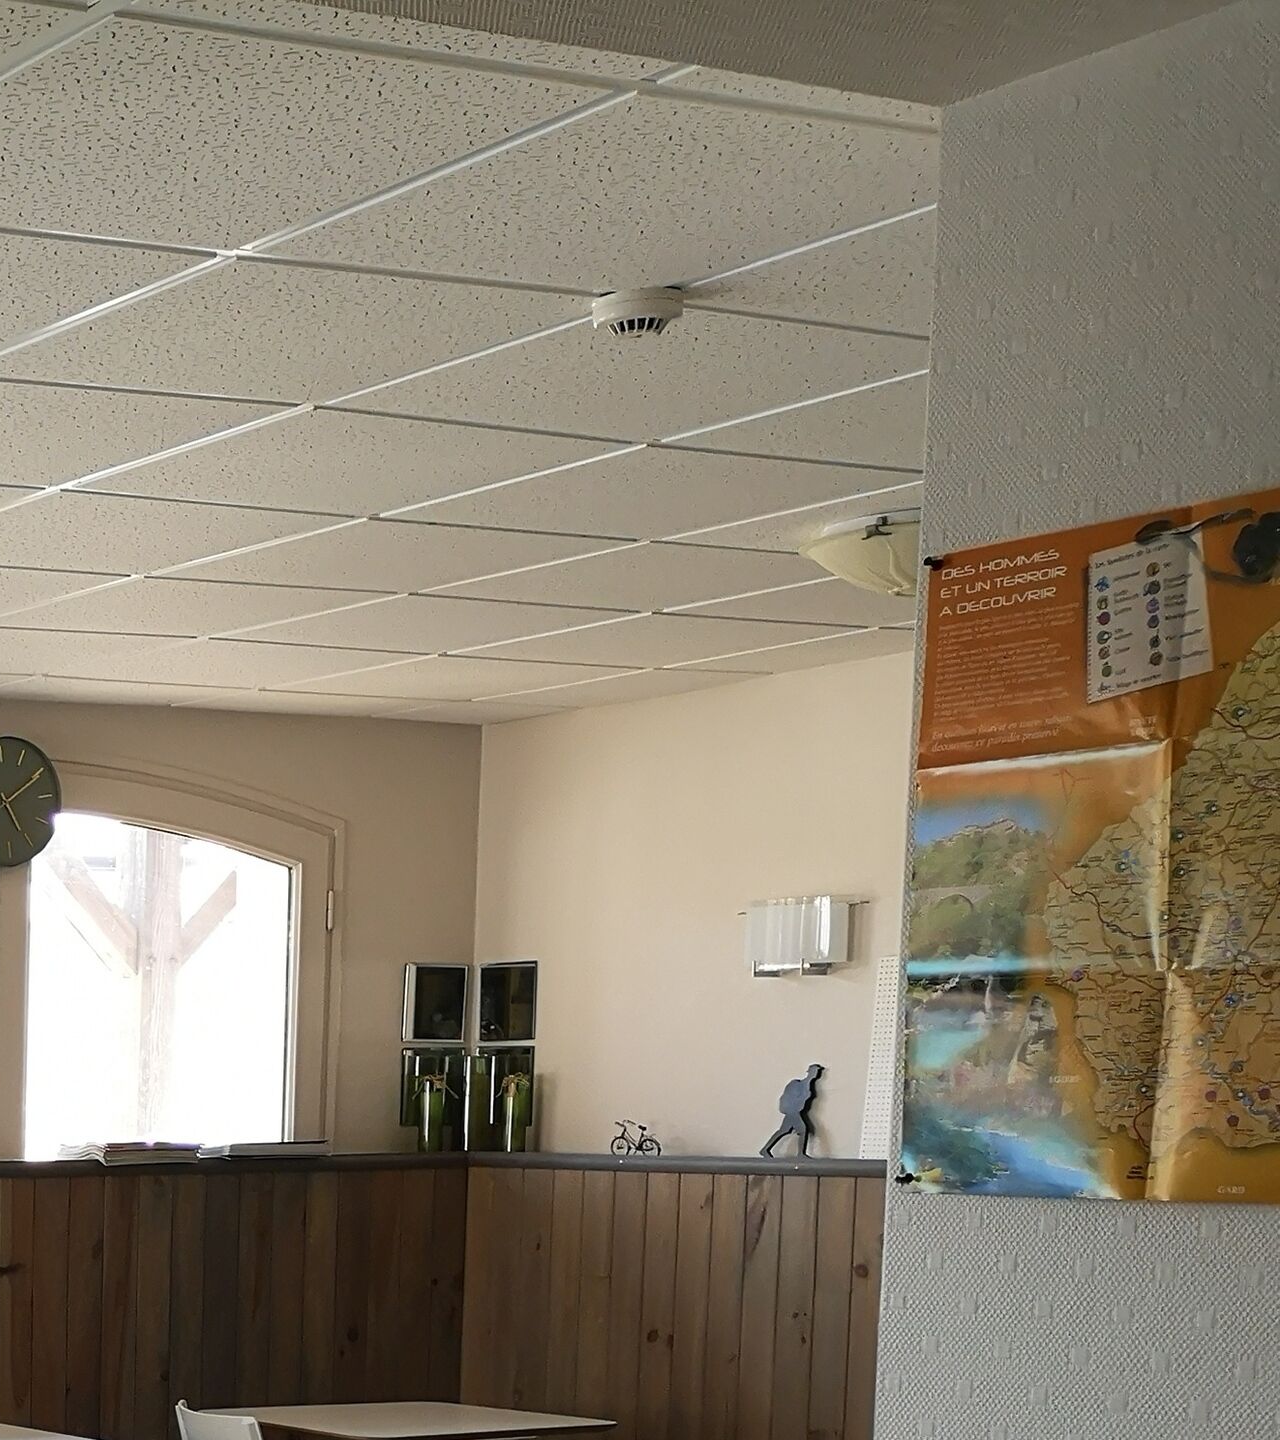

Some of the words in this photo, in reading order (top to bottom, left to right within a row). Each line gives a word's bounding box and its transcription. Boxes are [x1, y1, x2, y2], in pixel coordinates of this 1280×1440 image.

[941, 564, 975, 580] DES
[979, 549, 1060, 573] HOMMES
[940, 585, 963, 599] ET
[965, 580, 991, 594] UN
[993, 565, 1068, 588] TERROIR
[939, 606, 953, 618] A
[956, 587, 1057, 615] DECOUVRIR
